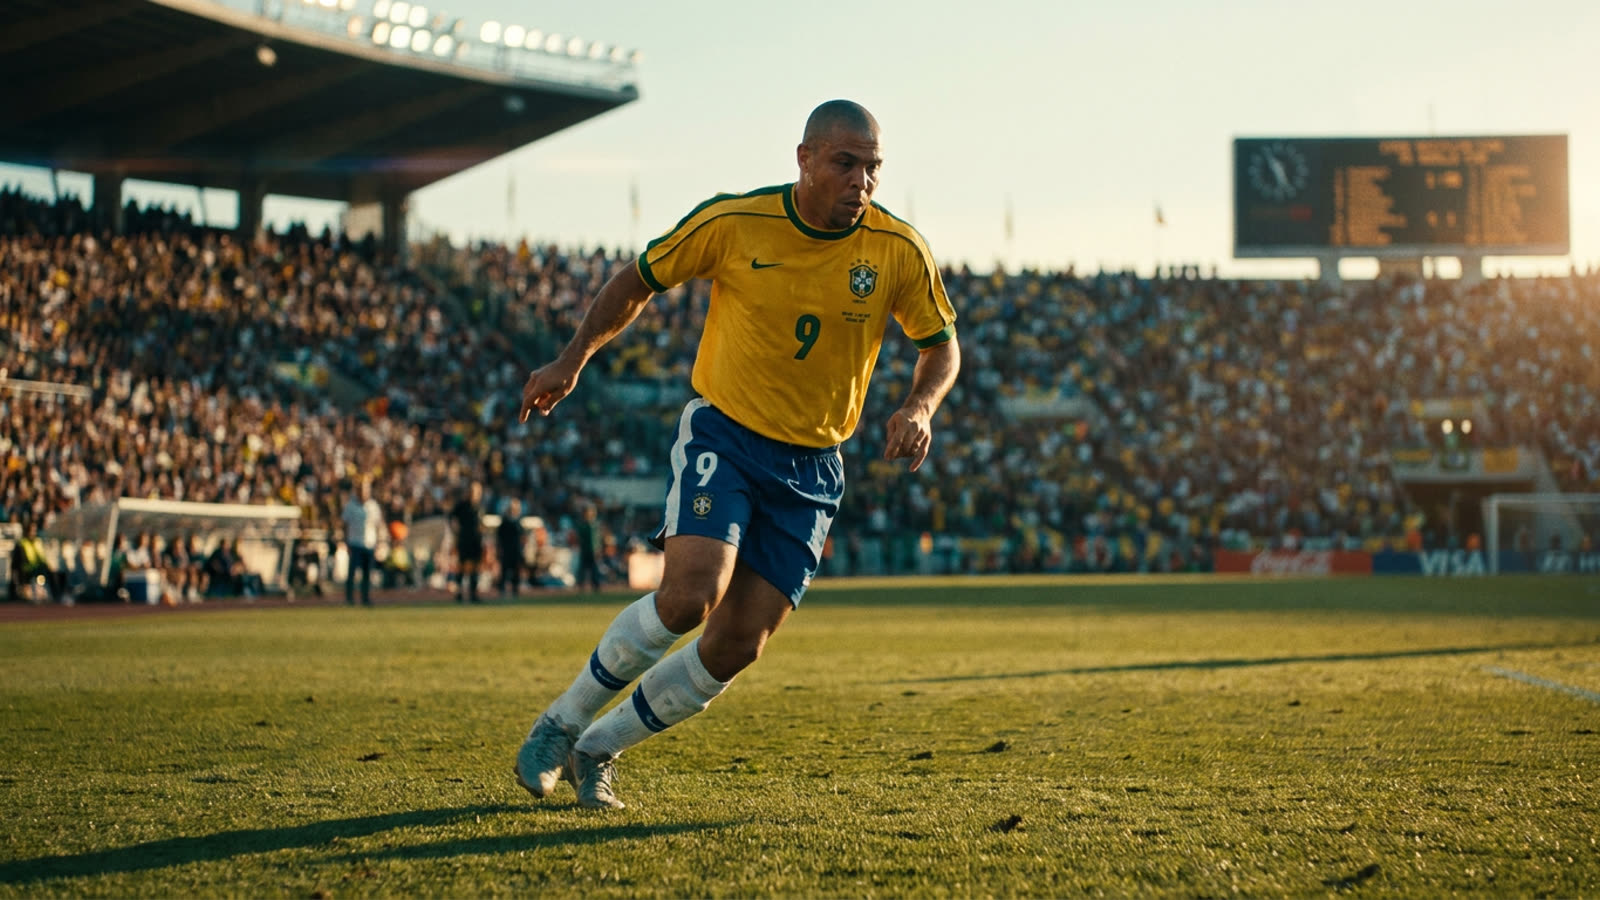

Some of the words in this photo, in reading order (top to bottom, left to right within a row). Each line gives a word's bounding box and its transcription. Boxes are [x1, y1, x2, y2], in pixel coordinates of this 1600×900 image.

[794, 314, 821, 360] 9
[696, 451, 718, 486] 9
[1419, 549, 1484, 576] VISA
